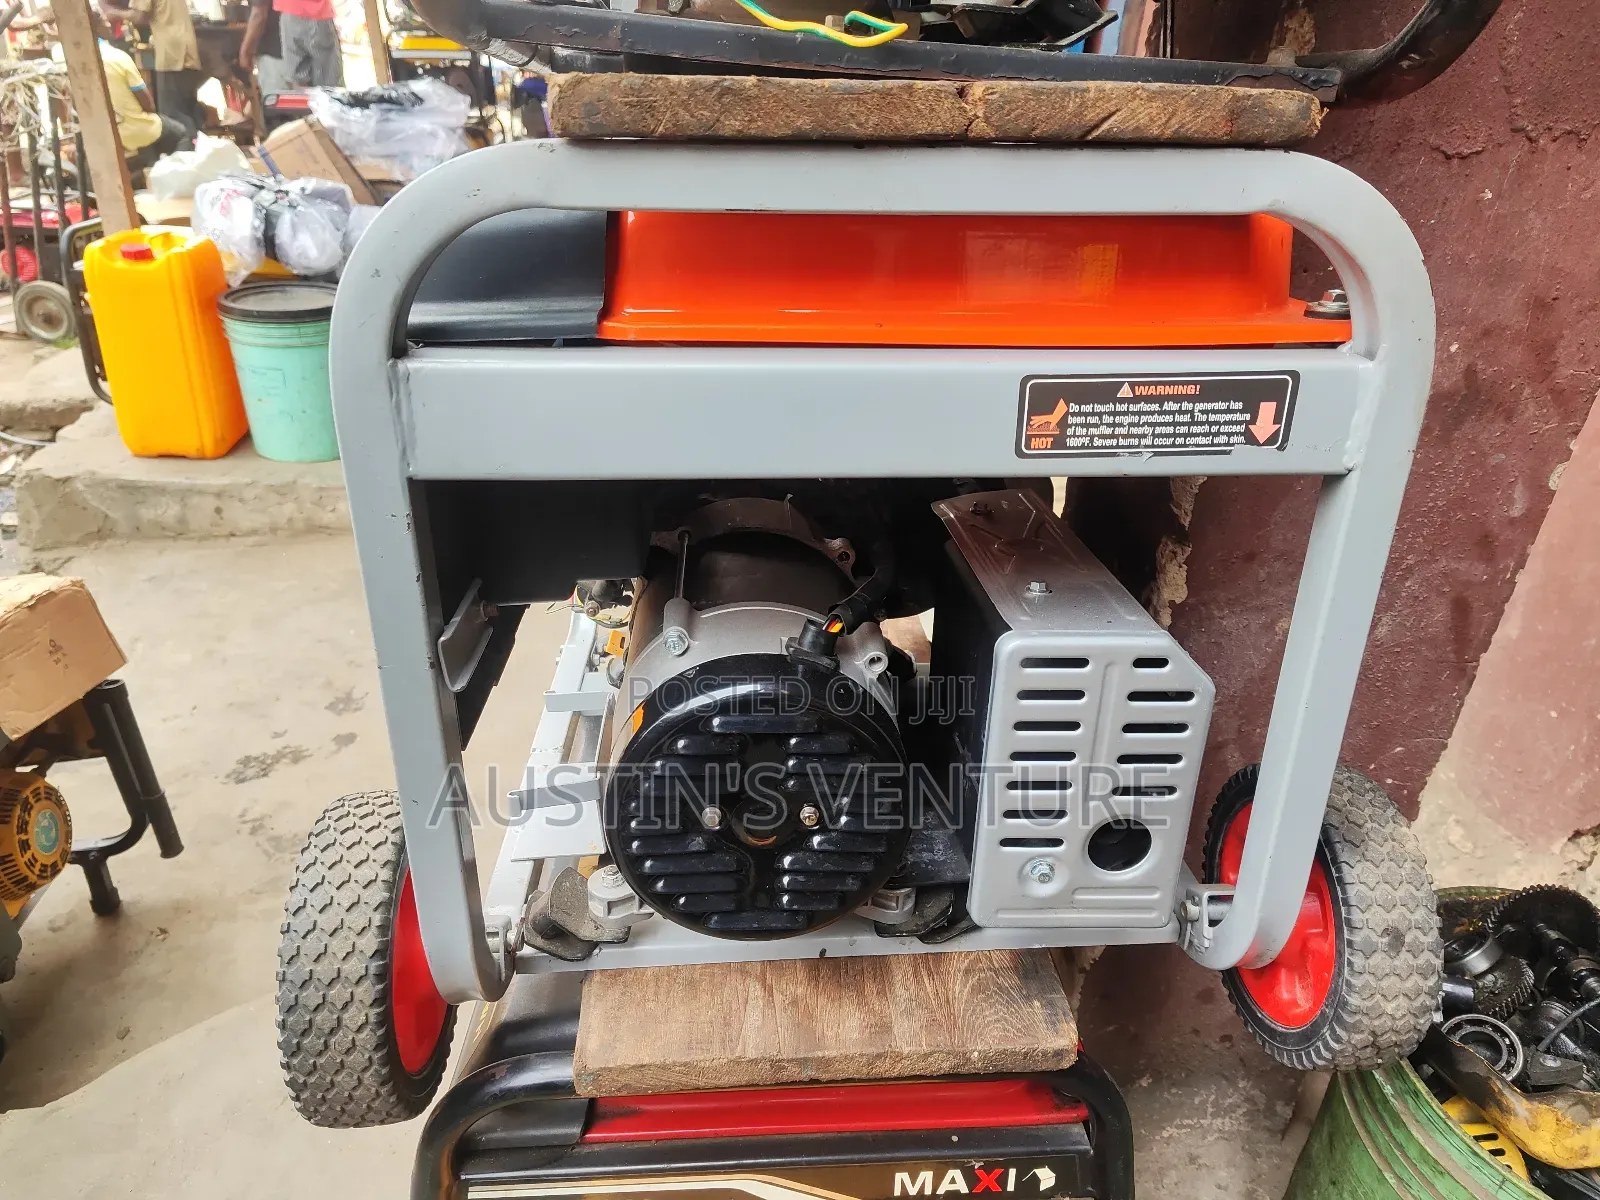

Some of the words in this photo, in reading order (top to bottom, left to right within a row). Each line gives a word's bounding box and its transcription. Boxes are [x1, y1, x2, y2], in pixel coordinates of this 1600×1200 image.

[1134, 385, 1200, 396] WARNING!
[1069, 403, 1079, 412] Do
[1081, 402, 1093, 412] not
[1094, 402, 1114, 412] touch
[1116, 401, 1128, 412] hot
[1129, 401, 1161, 412] surfaces.
[1163, 401, 1180, 411] After
[1182, 400, 1193, 410] the
[1195, 400, 1228, 412] generator
[1230, 400, 1243, 409] has
[1068, 415, 1085, 424] been
[1087, 416, 1101, 425] run,
[1102, 414, 1114, 423] the
[1115, 414, 1139, 426] engine
[1140, 414, 1173, 425] produces
[1175, 413, 1192, 422] heat.
[1194, 413, 1208, 422] The
[1209, 412, 1250, 423] temperature
[1067, 427, 1075, 435] of
[1076, 426, 1087, 435] the
[1088, 426, 1113, 436] muffler
[1114, 425, 1128, 435] and
[1129, 425, 1154, 437] nearby
[1155, 425, 1174, 433] areas
[1176, 425, 1189, 433] can
[1190, 423, 1210, 433] reach
[1220, 423, 1245, 433] exceed
[1030, 438, 1053, 449] HOT
[1093, 437, 1117, 447] Severe
[1118, 437, 1139, 446] burns
[1141, 436, 1153, 446] will
[1154, 437, 1174, 445] occur
[1187, 436, 1213, 444] contact
[1214, 435, 1229, 444] with
[1230, 434, 1246, 443] skin.
[893, 1168, 1016, 1196] MAXI
